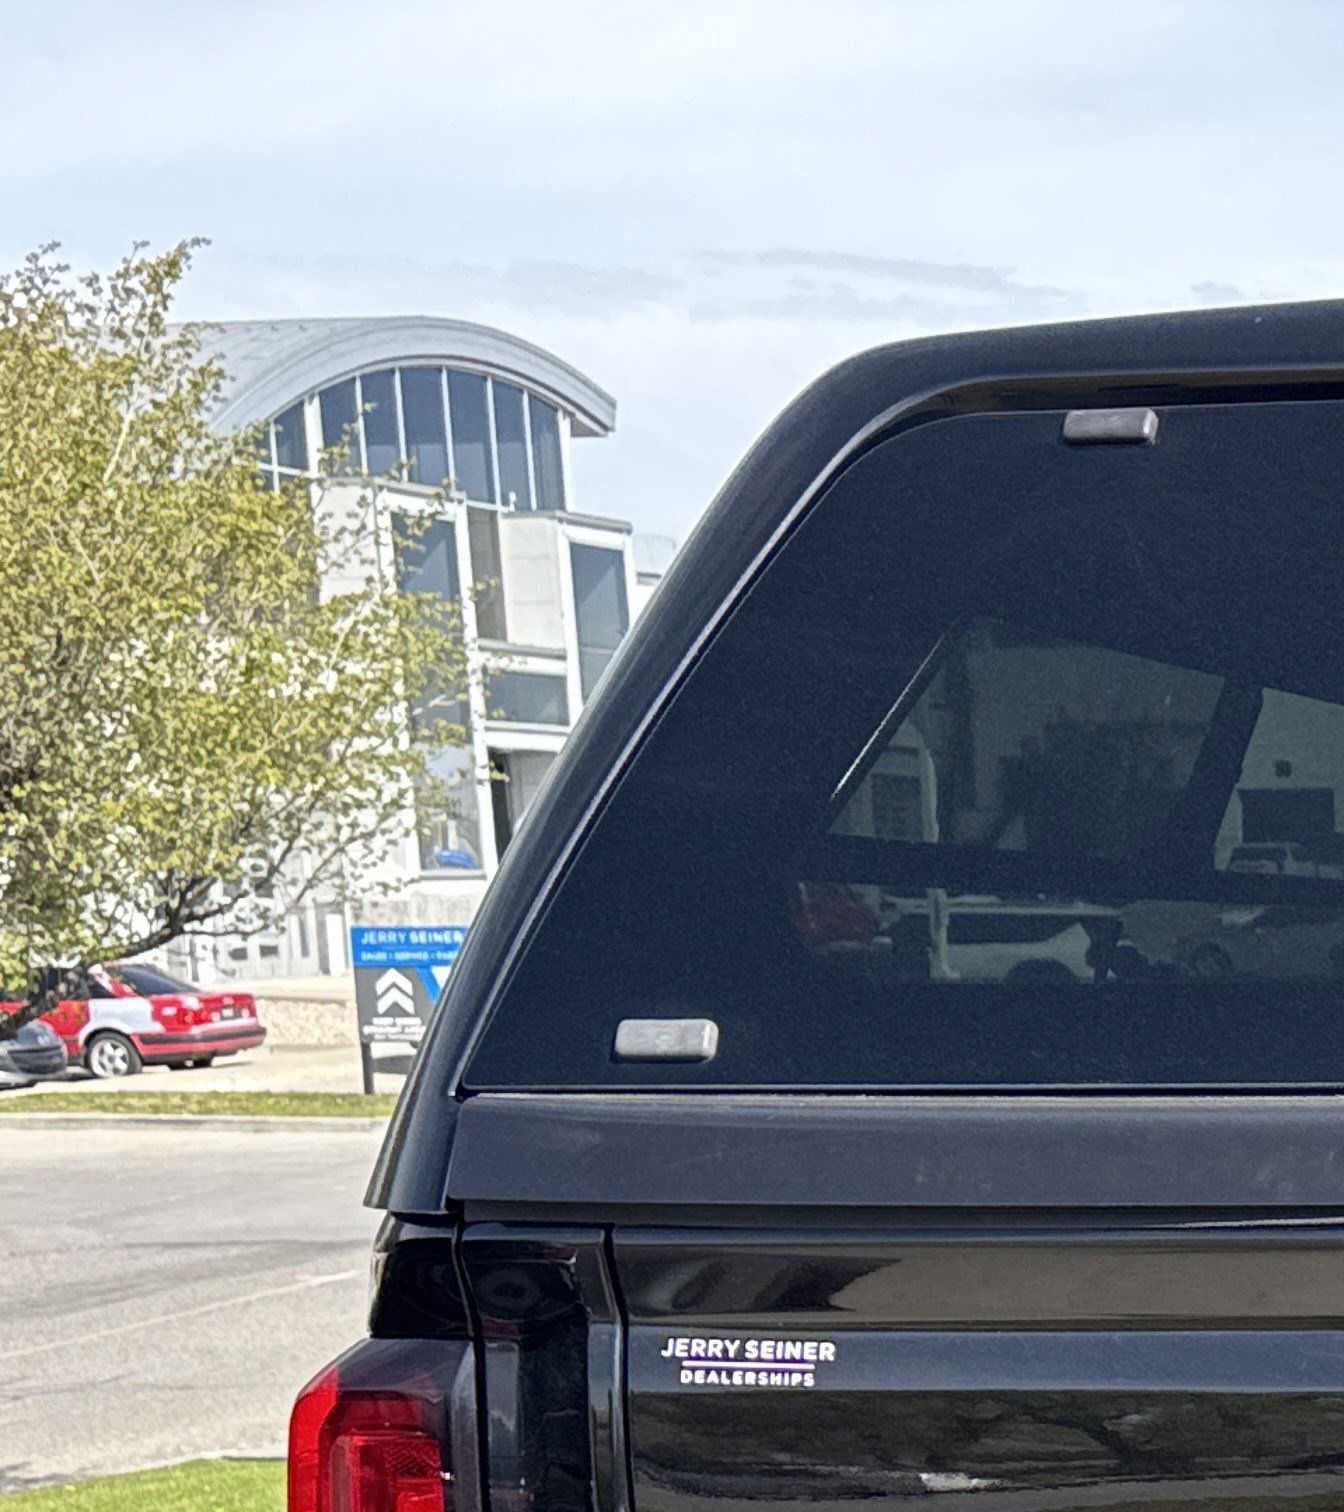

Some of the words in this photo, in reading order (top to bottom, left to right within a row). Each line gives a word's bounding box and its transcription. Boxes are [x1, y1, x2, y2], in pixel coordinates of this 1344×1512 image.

[361, 930, 406, 945] JERRY
[660, 1337, 741, 1359] JERRY
[744, 1339, 836, 1362] SEINER
[680, 1370, 815, 1387] DEALERSHIPS
